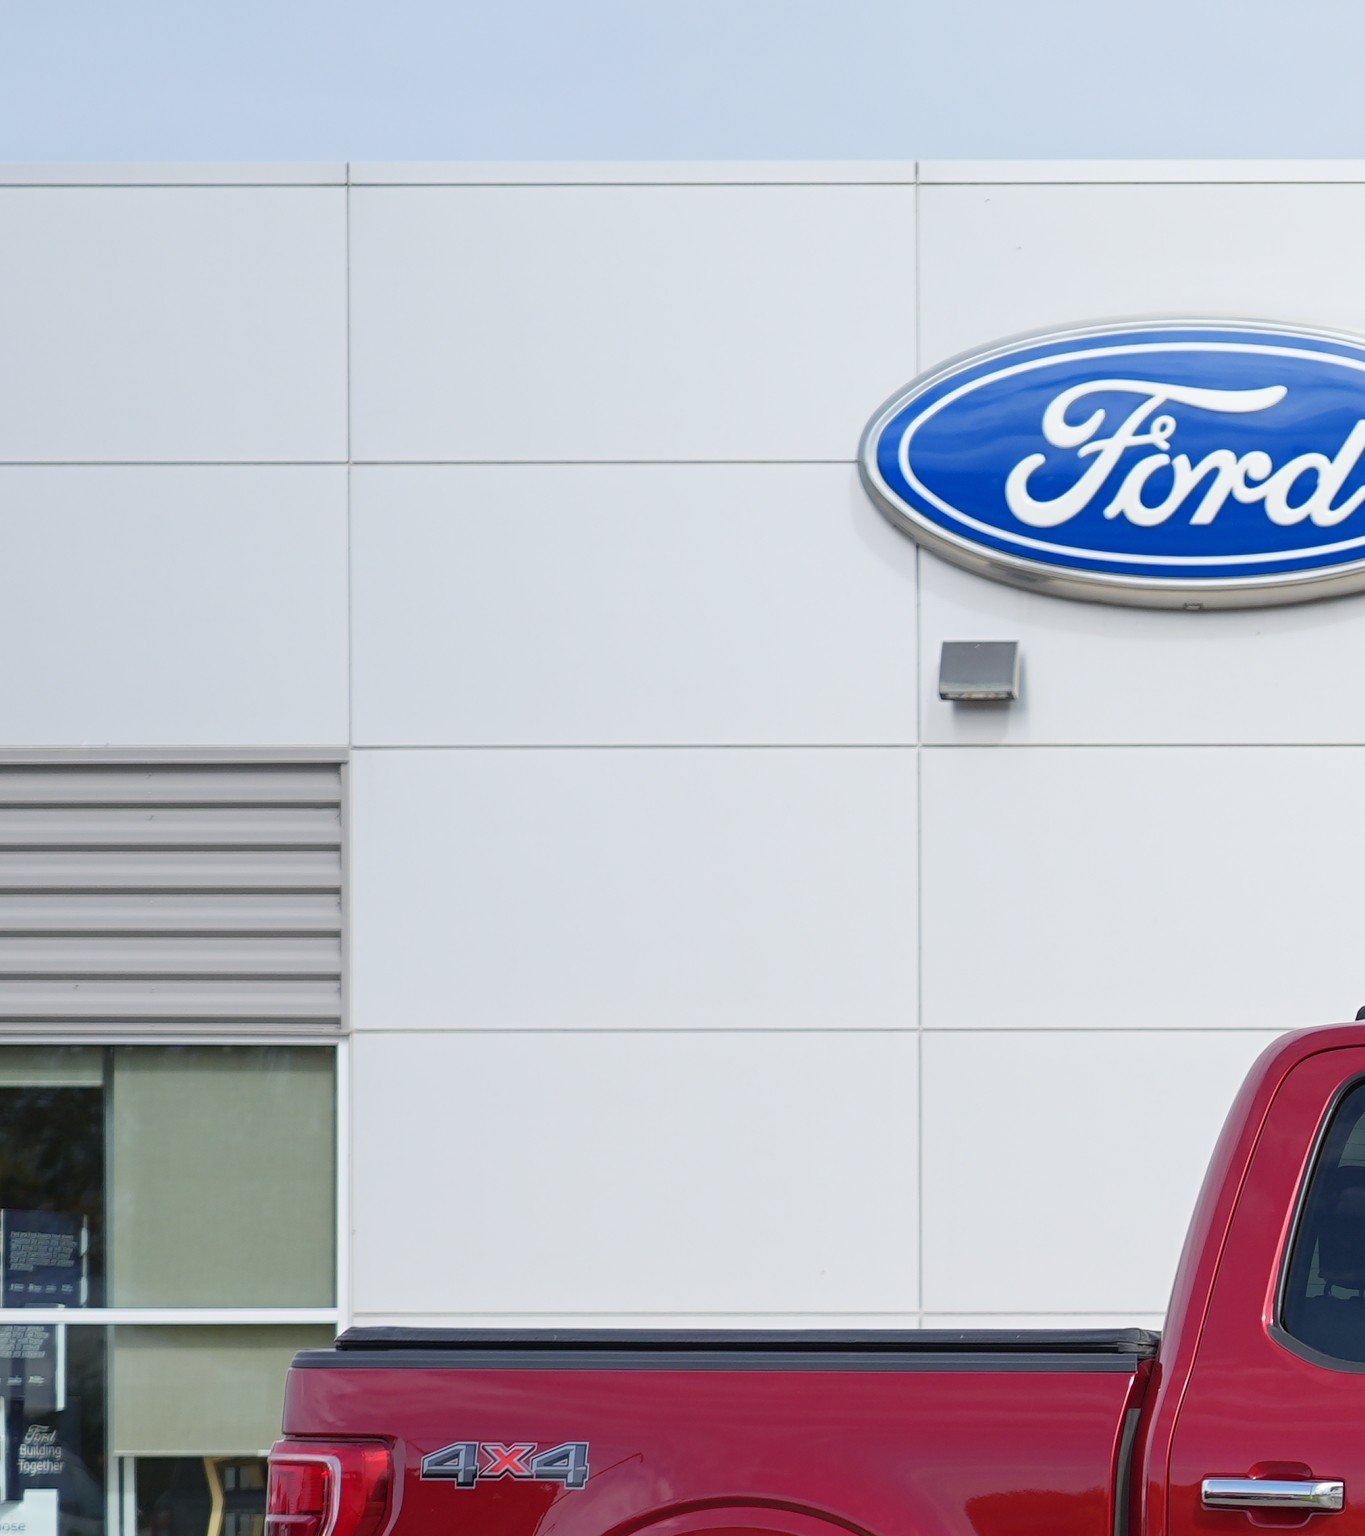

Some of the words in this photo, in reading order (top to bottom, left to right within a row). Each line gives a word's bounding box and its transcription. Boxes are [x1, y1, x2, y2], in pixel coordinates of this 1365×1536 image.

[24, 1424, 57, 1444] Ford
[20, 1444, 62, 1459] Building
[19, 1459, 64, 1477] Together
